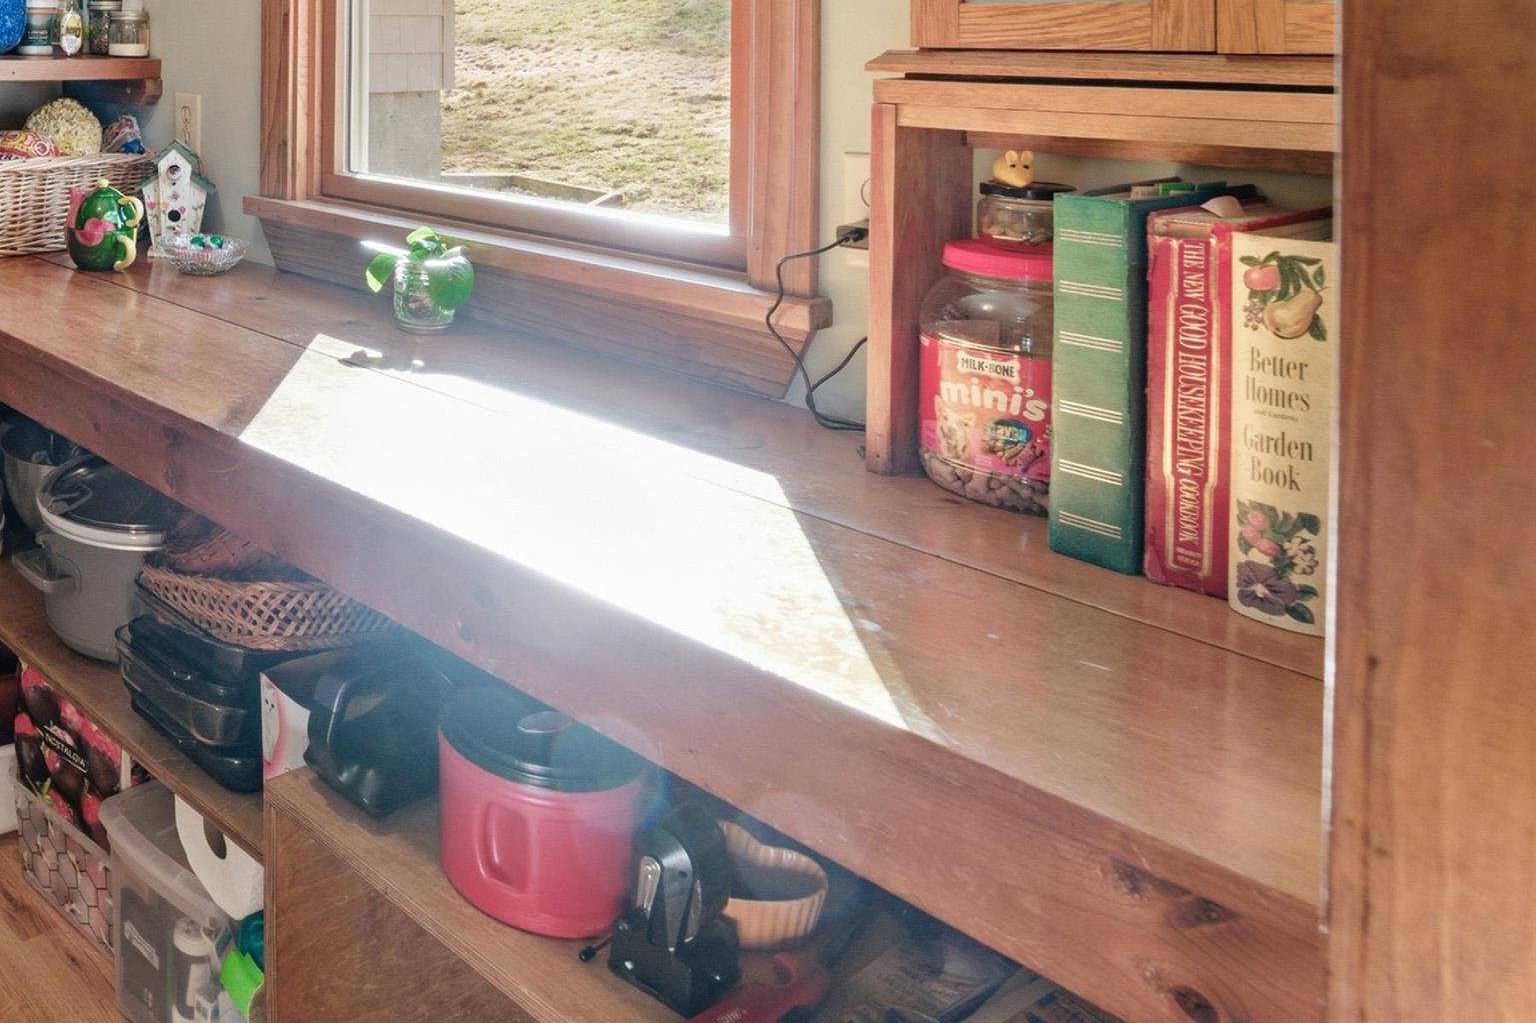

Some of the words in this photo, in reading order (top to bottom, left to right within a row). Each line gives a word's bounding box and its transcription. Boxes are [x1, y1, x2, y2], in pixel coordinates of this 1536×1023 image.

[1183, 242, 1206, 269] THE
[1183, 271, 1206, 302] NEW
[1179, 304, 1209, 350] GOOD
[961, 356, 1016, 379] MILK-BONE
[1249, 346, 1309, 381] Better
[940, 377, 1048, 422] mini's
[1245, 375, 1311, 412] Homes
[1176, 351, 1207, 477] HOUSEKEEPING
[1243, 424, 1313, 462] Garden
[1250, 456, 1302, 492] Book
[1179, 478, 1201, 545] COOKBOOK
